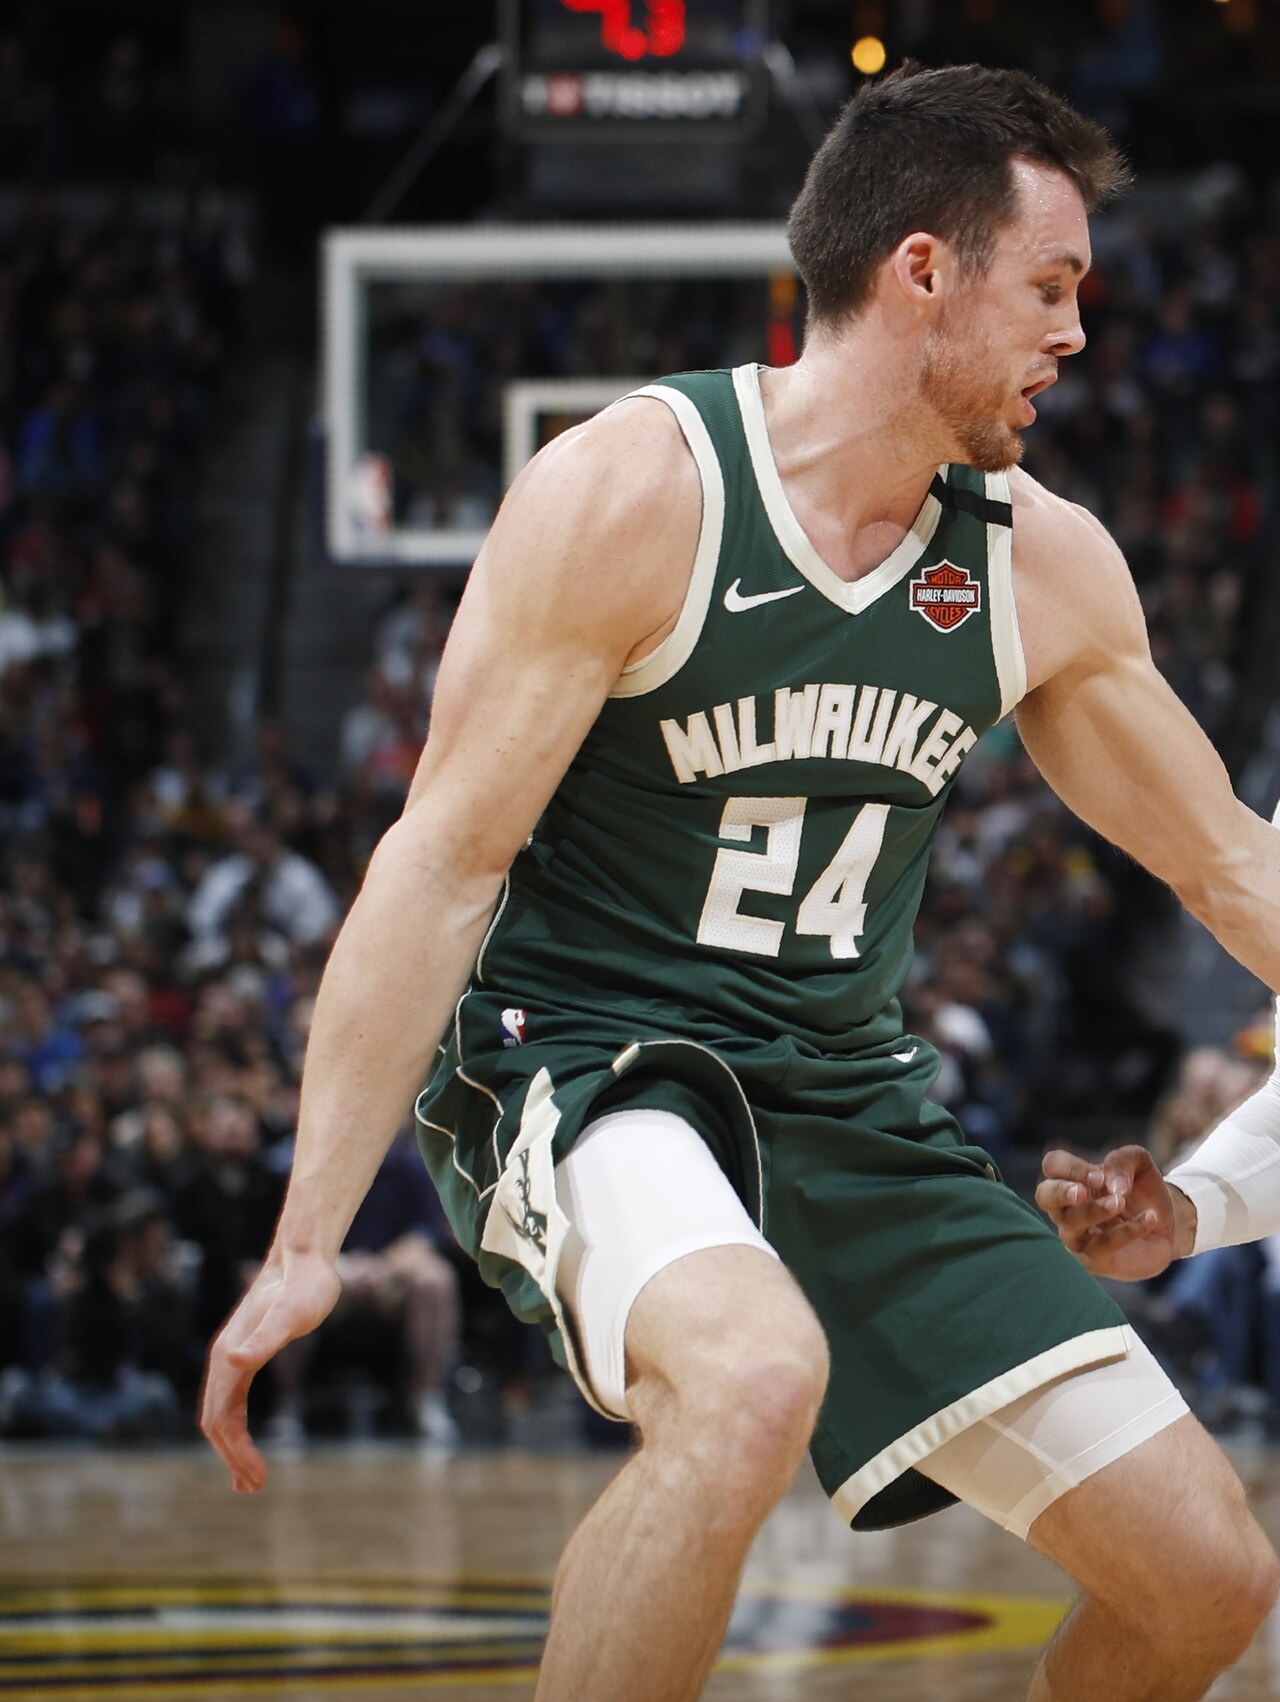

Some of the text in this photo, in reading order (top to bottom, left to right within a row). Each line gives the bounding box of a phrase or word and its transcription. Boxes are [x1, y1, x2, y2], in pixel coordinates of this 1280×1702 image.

[930, 571, 962, 585] MOTOR
[916, 588, 975, 603] HARLEY-DAVIDSON
[696, 796, 892, 959] 24
